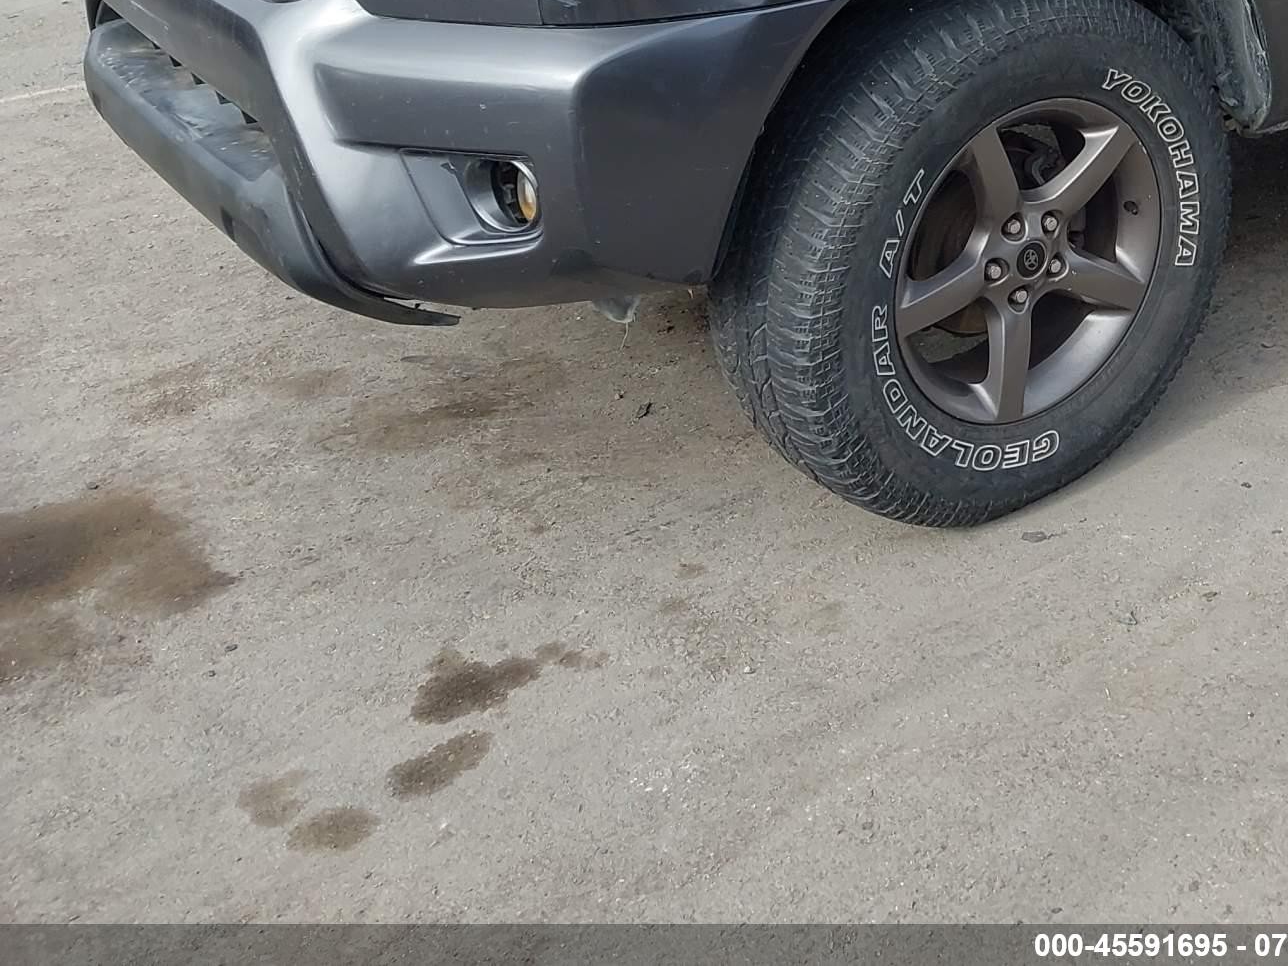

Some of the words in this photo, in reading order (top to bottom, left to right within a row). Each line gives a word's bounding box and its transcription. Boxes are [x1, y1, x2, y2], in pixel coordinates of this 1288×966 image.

[879, 168, 925, 278] A/T
[1102, 68, 1200, 266] YOKOHAMA
[872, 304, 1060, 472] GEOLANDAR
